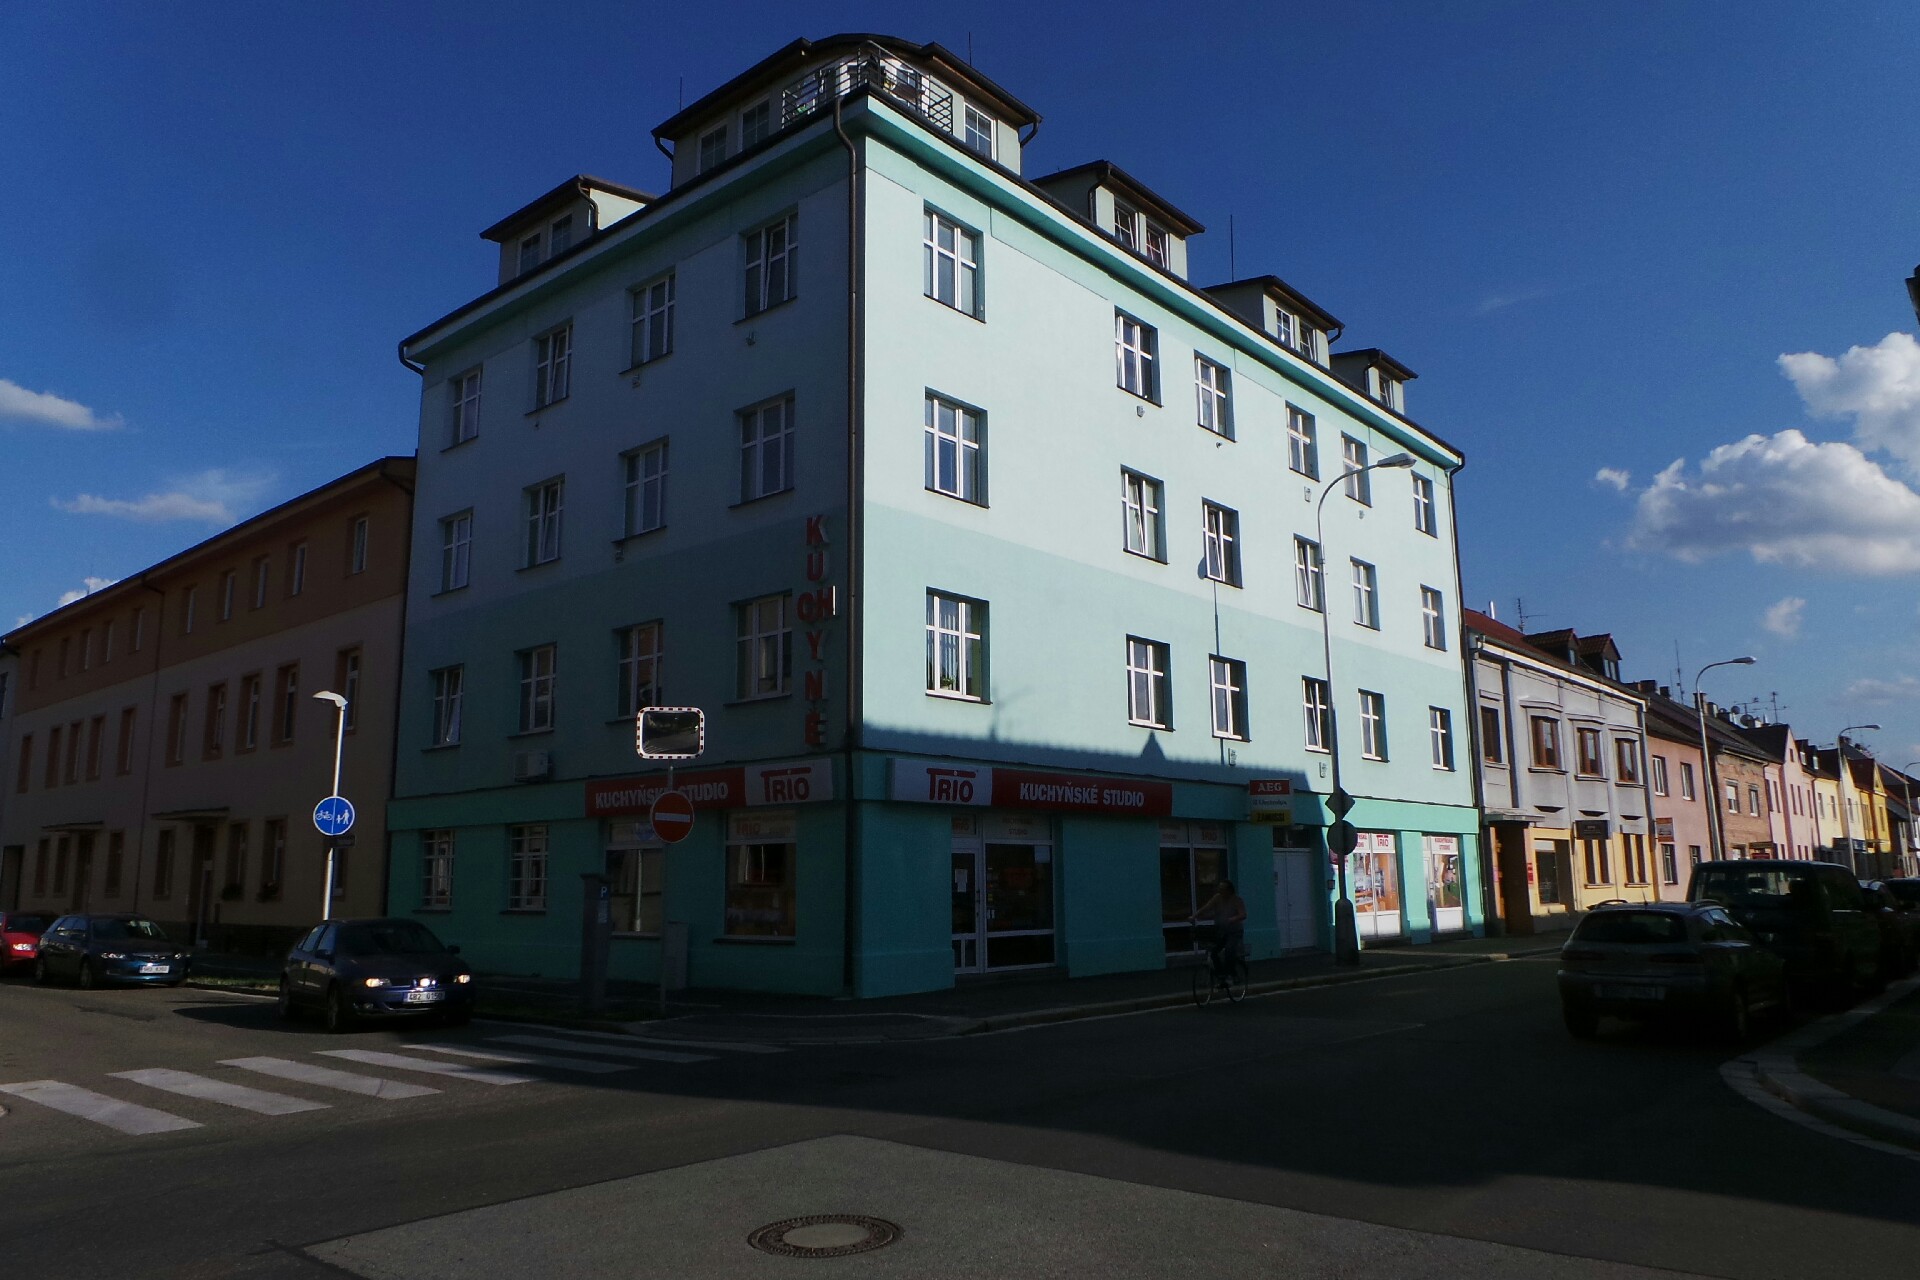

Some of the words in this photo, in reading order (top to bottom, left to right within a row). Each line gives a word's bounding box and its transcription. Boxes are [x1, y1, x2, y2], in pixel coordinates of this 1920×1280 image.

[760, 767, 812, 802] TRIO
[926, 767, 977, 802] TRIO
[1019, 780, 1099, 805] KUCHYŇSKÉ
[1103, 788, 1145, 808] STUDIO
[1257, 782, 1283, 792] AEG
[600, 886, 608, 898] P
